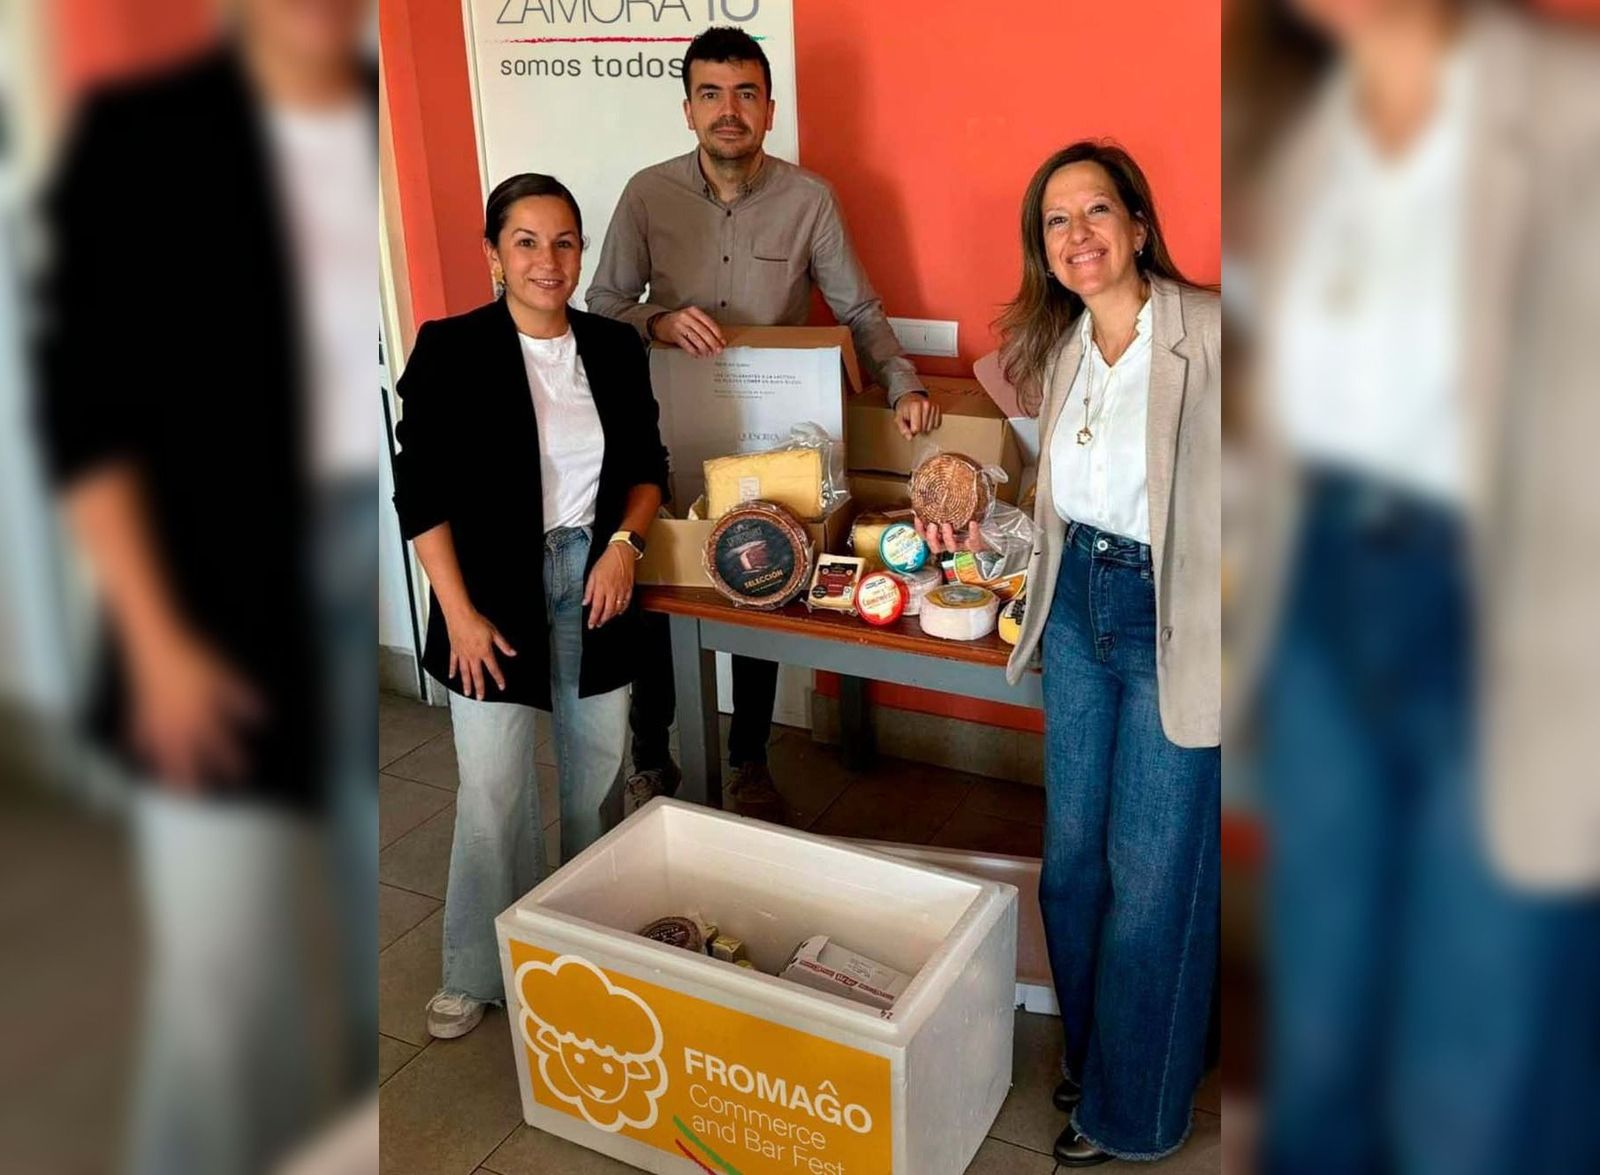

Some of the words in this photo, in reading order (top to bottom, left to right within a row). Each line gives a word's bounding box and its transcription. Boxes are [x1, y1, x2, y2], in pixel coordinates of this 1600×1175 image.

[500, 57, 581, 77] somos
[592, 52, 684, 78] todos
[689, 1084, 826, 1149] Commerce
[692, 1114, 736, 1145] and
[745, 1128, 784, 1160] Bar
[793, 1145, 845, 1175] Fest
